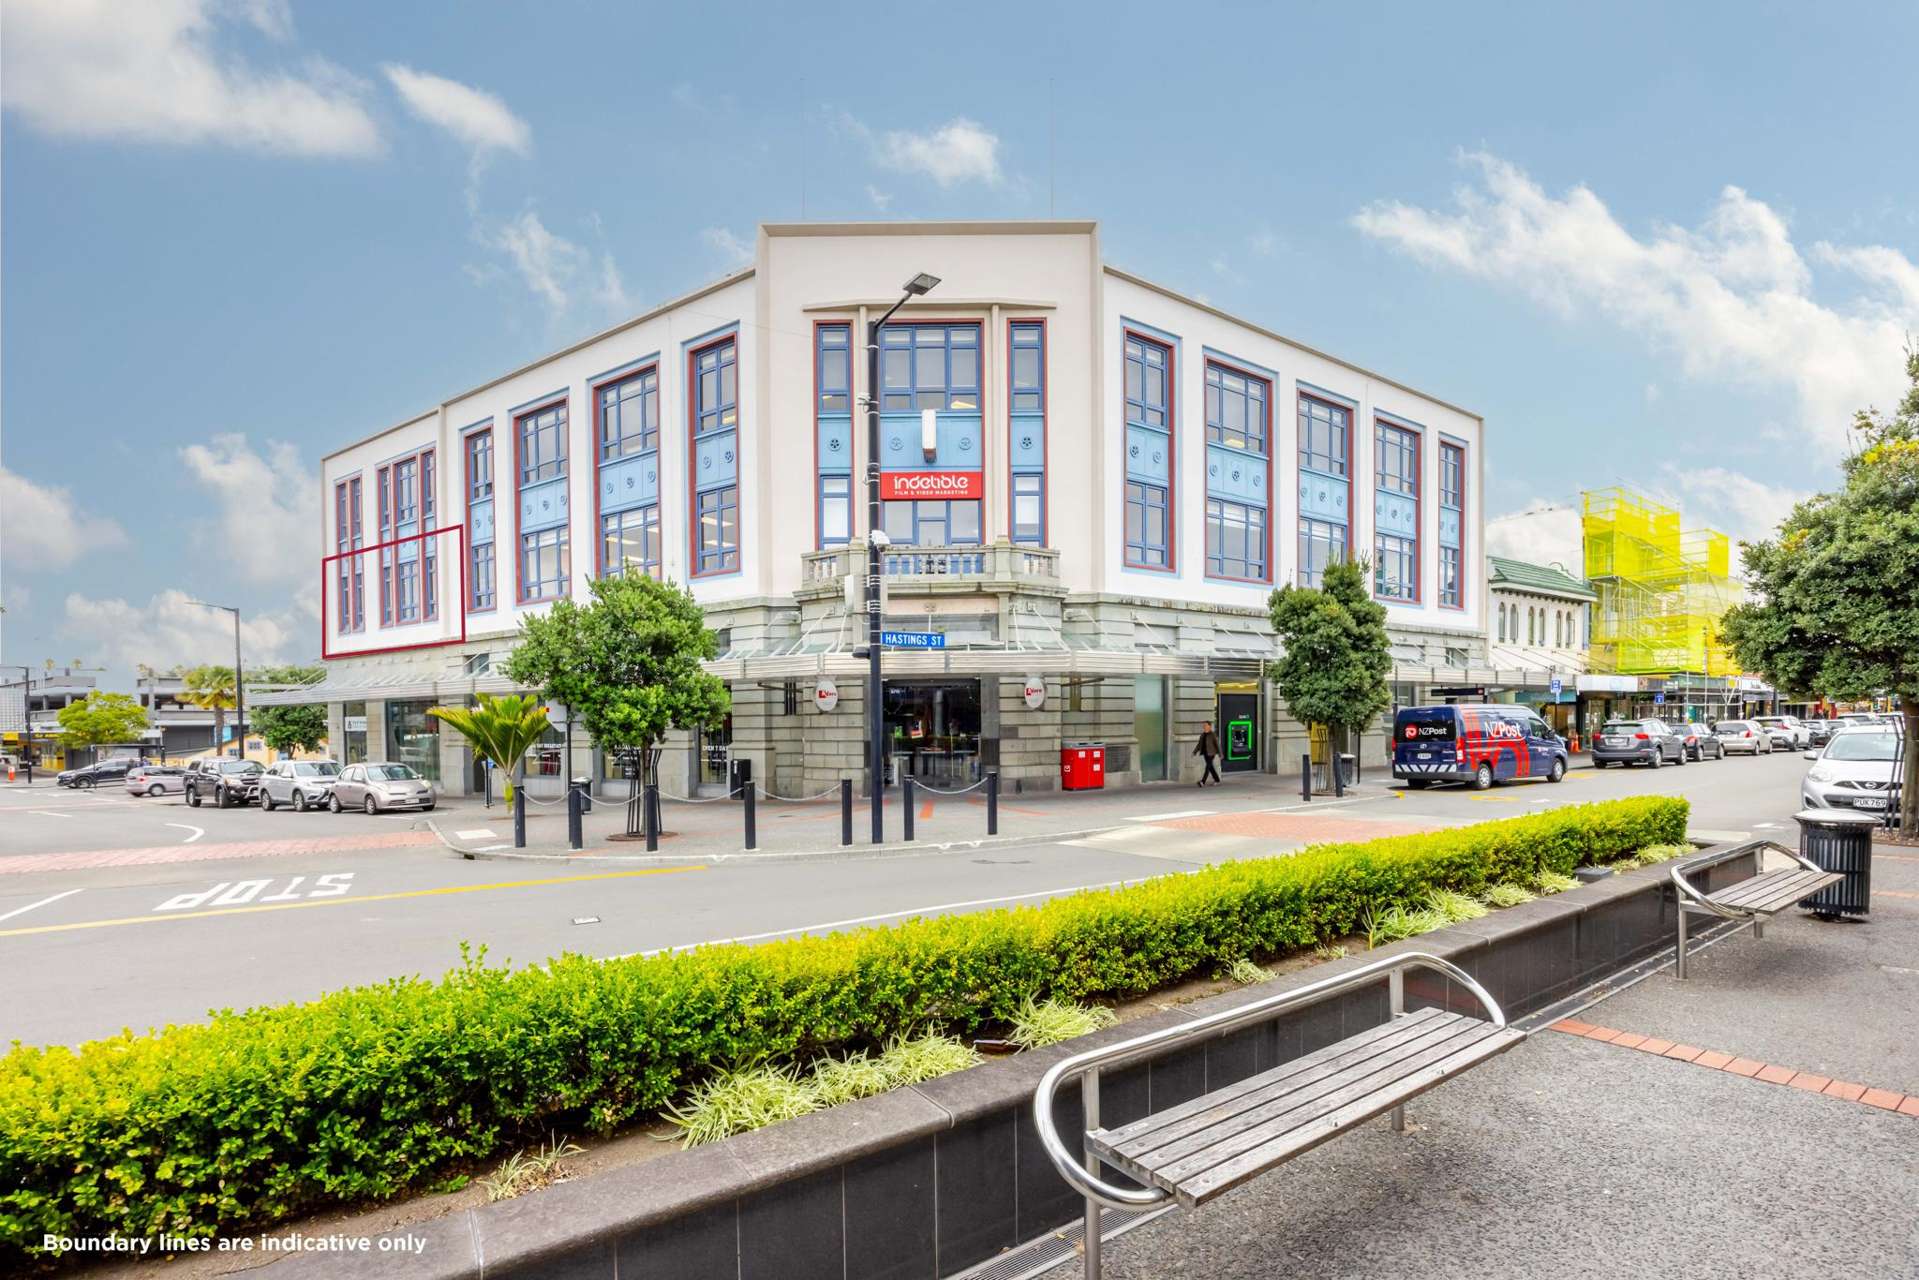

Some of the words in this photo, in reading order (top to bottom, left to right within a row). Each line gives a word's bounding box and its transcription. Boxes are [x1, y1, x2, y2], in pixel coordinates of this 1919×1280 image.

[894, 475, 968, 489] indelible
[885, 634, 927, 646] HASTINGS
[931, 635, 942, 646] ST
[1418, 727, 1448, 736] NZPost
[1484, 720, 1522, 738] NZPost
[152, 872, 355, 912] STOP
